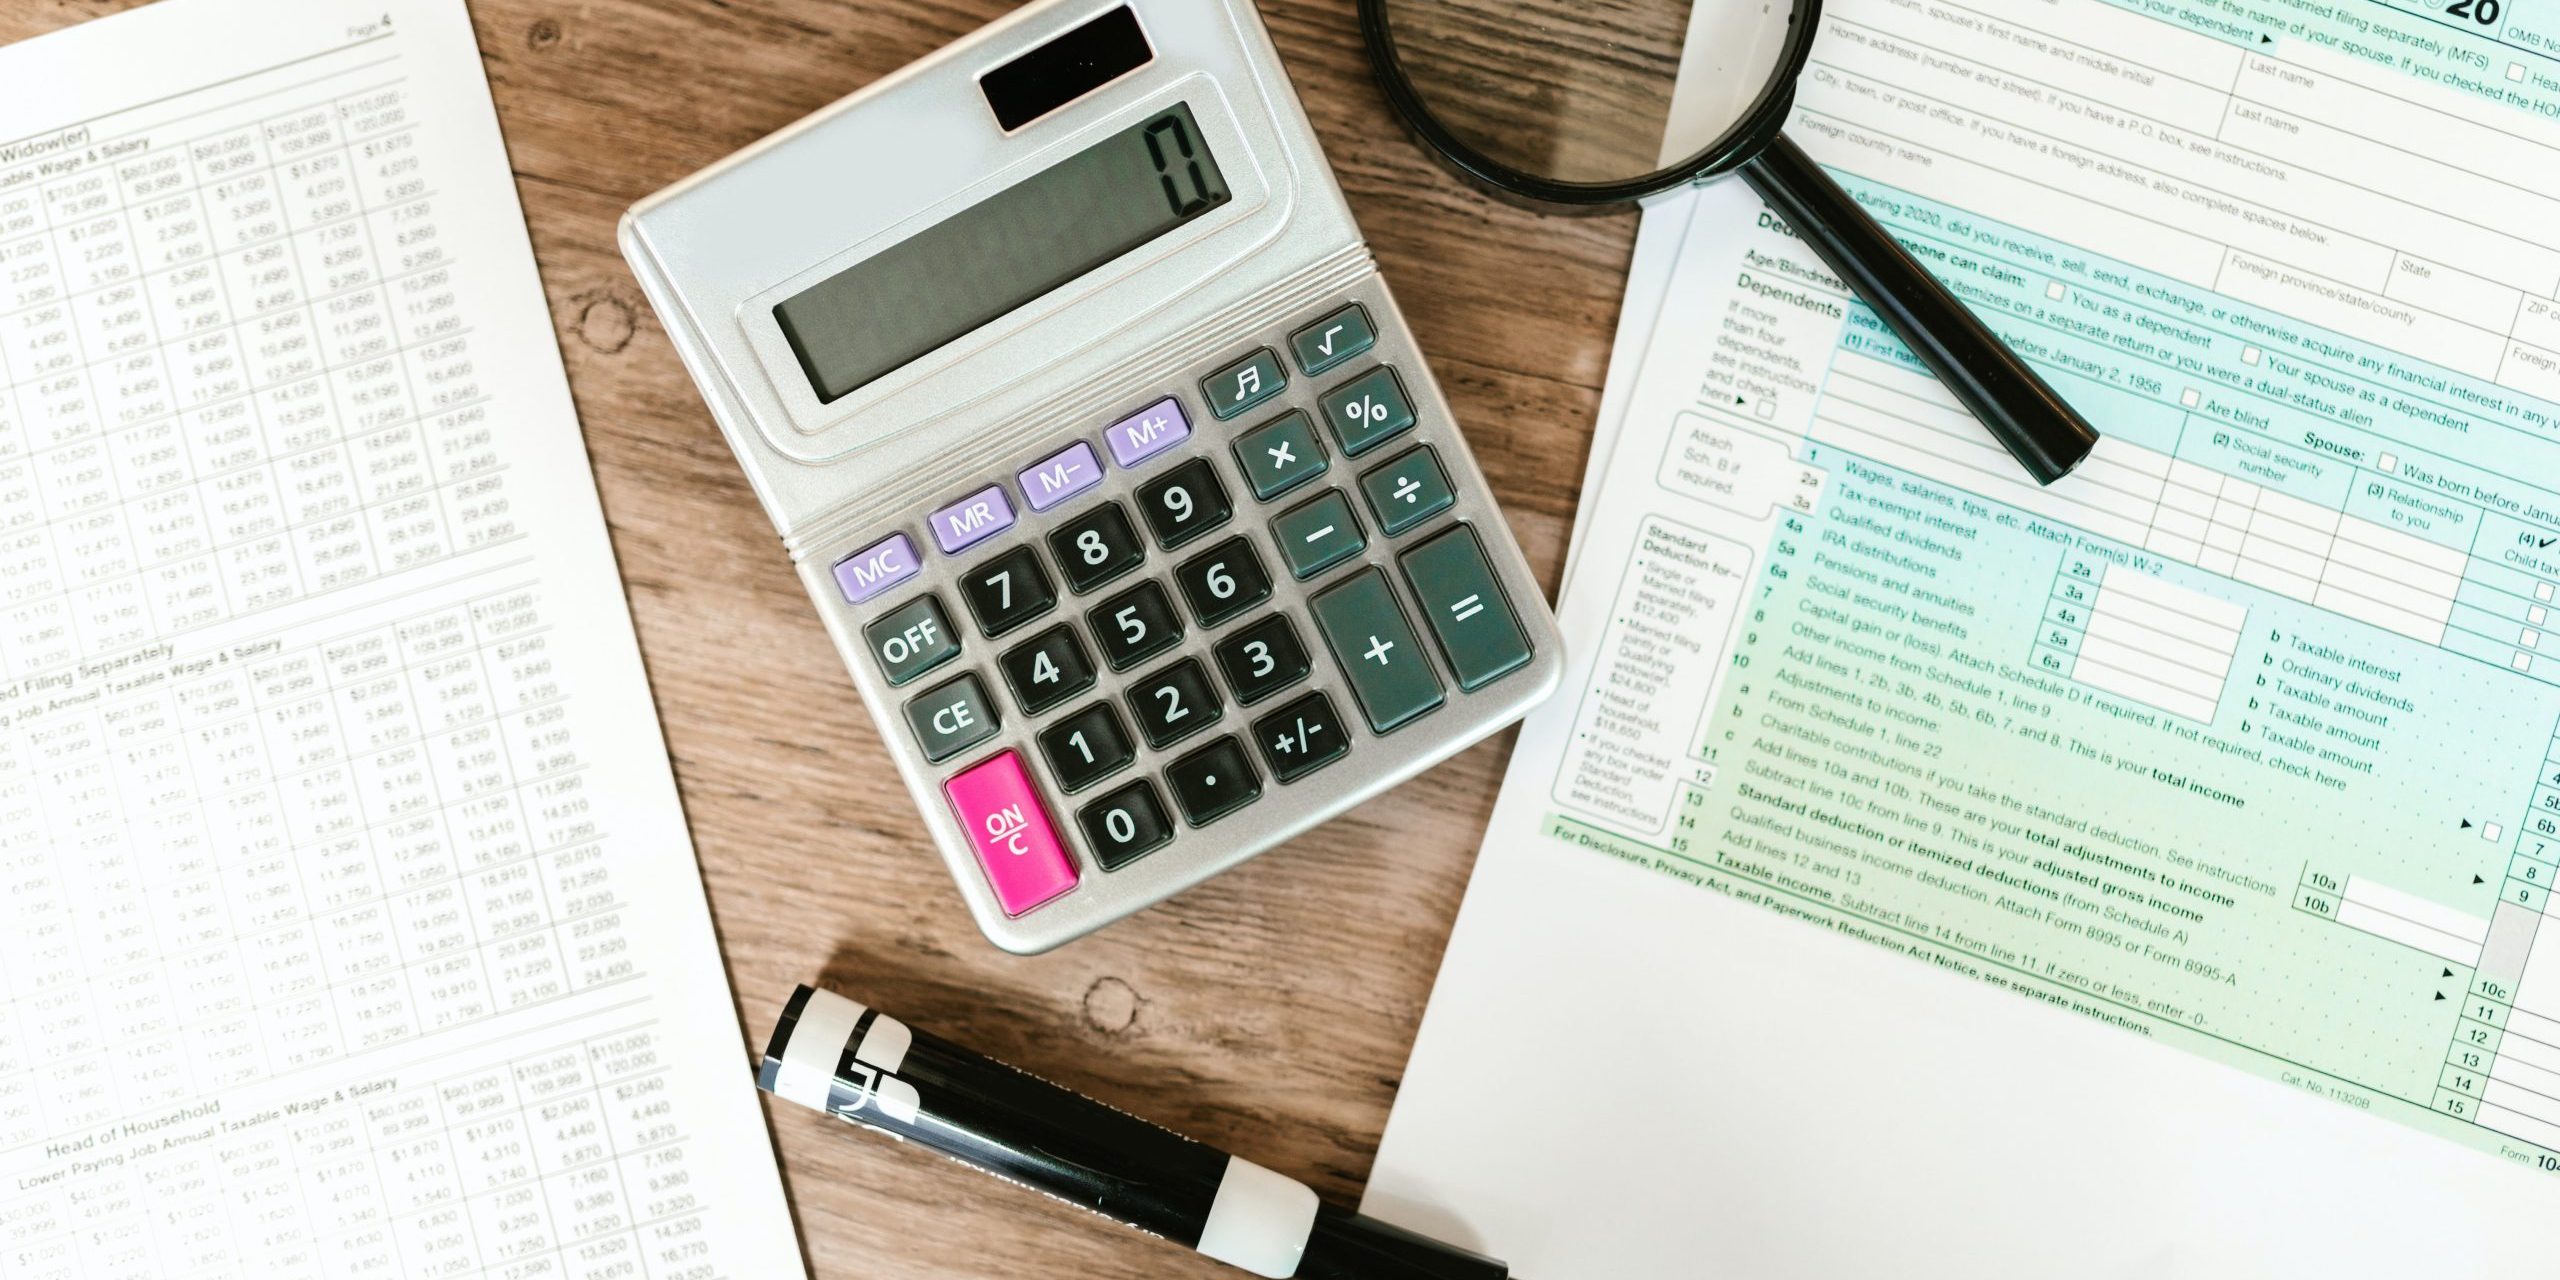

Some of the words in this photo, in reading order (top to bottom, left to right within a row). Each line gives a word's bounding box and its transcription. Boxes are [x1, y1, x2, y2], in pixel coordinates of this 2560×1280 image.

[2141, 0, 2177, 16] your
[2178, 7, 2255, 43] dependent
[2507, 26, 2541, 47] OMB
[2221, 0, 2245, 17] the
[2246, 9, 2287, 31] name
[2289, 23, 2306, 36] of
[2306, 28, 2340, 47] your
[2341, 40, 2396, 67] spouse.
[2400, 56, 2412, 71] If
[2412, 63, 2441, 81] you
[2442, 72, 2505, 101] checked
[2506, 91, 2530, 109] the
[2335, 8, 2369, 34] filing
[2371, 23, 2445, 58] separately
[2447, 45, 2490, 72] (MFS)
[2249, 58, 2278, 77] Last
[2278, 69, 2315, 89] name
[0, 126, 91, 163] Widow(er)
[37, 156, 83, 177] Wage
[86, 149, 99, 164] &
[100, 137, 150, 159] Salary
[2400, 258, 2432, 279] State
[1737, 272, 1843, 320] Dependents
[2230, 253, 2279, 281] Foreign
[2279, 272, 2416, 327] province/state/county
[2135, 282, 2206, 316] exchange,
[2211, 308, 2228, 321] or
[2229, 314, 2299, 345] otherwise
[2301, 337, 2355, 364] acquire
[2357, 356, 2385, 375] any
[2386, 362, 2447, 393] financial
[2449, 382, 2503, 412] interest
[2505, 401, 2520, 417] in
[2521, 409, 2550, 429] any
[1346, 395, 1387, 428] %
[2268, 355, 2301, 378] Your
[2303, 370, 2356, 396] spouse
[2358, 389, 2376, 403] as
[2378, 395, 2389, 408] a
[2392, 399, 2470, 434] dependent
[2204, 399, 2231, 418] Are
[2233, 407, 2270, 431] blind
[1127, 417, 1167, 448] M+
[2303, 431, 2365, 462] Spouse:
[2212, 430, 2231, 449] (2)
[2232, 437, 2272, 460] Social
[2273, 454, 2324, 479] security
[2238, 459, 2288, 483] number
[1164, 487, 1192, 522] 9
[2367, 481, 2385, 500] (3)
[2387, 488, 2464, 524] Relationship
[2403, 463, 2434, 485] Was
[2437, 474, 2471, 497] born
[2473, 486, 2520, 513] before
[950, 503, 994, 536] MR
[2391, 508, 2404, 522] to
[2405, 515, 2431, 531] you
[1077, 531, 1108, 564] 8
[2504, 548, 2539, 569] Child
[2540, 560, 2560, 577] tax
[854, 549, 900, 587] MC
[1207, 563, 1235, 598] 6
[986, 571, 1010, 609] 7
[884, 619, 936, 663] OFF
[1116, 606, 1146, 643] 5
[23, 672, 74, 695] Filing
[77, 643, 175, 680] Separately
[1034, 651, 1059, 683] 4
[1244, 641, 1274, 677] 3
[2270, 628, 2281, 643] b
[2291, 634, 2345, 665] Taxable
[2347, 657, 2402, 684] interest
[15, 705, 43, 722] Job
[47, 687, 101, 712] Annual
[105, 671, 166, 695] Taxable
[168, 657, 214, 678] Wage
[218, 651, 230, 666] &
[233, 639, 282, 661] Salary
[934, 701, 974, 734] CE
[1157, 686, 1188, 722] 2
[1070, 731, 1094, 763] 1
[1275, 718, 1321, 753] +/-
[2152, 768, 2187, 789] total
[2189, 780, 2245, 809] income
[985, 805, 1025, 838] ON
[1106, 809, 1134, 842] 0
[2537, 818, 2557, 835] 6b
[1008, 832, 1029, 856] C
[2535, 842, 2545, 856] 7
[1737, 782, 1807, 817] Standard
[1809, 808, 1885, 843] deduction
[1887, 836, 1905, 848] or
[1907, 840, 1974, 872] itemized
[1975, 863, 2060, 901] deductions
[2062, 892, 2100, 915] (from
[2103, 906, 2170, 938] Schedule
[2172, 929, 2189, 946] A)
[2525, 866, 2537, 880] 8
[2032, 859, 2100, 889] adjusted
[2102, 882, 2145, 904] gross
[2148, 894, 2204, 923] income
[2312, 872, 2337, 891] 10a
[2518, 889, 2529, 903] 9
[2305, 895, 2330, 914] 10b
[1553, 824, 1576, 841] For
[1578, 833, 1651, 869] Disclosure,
[1654, 858, 1704, 887] Privacy
[1705, 877, 1731, 897] Act,
[1735, 889, 1762, 904] and
[1763, 895, 1834, 930] Paperwork
[1837, 921, 1906, 953] Reduction
[1907, 945, 1932, 963] Act
[1933, 953, 1980, 980] Notice,
[1983, 972, 2009, 988] see
[2010, 981, 2069, 1009] separate
[2071, 1000, 2153, 1037] instructions.
[2481, 981, 2507, 999] 10c
[2478, 1005, 2494, 1021] 11
[2470, 1029, 2488, 1045] 12
[2463, 1052, 2480, 1068] 13
[2280, 1071, 2303, 1088] Cat.
[2305, 1079, 2325, 1096] No.
[2328, 1087, 2371, 1110] 11320B
[2455, 1076, 2472, 1091] 14
[2447, 1098, 2465, 1114] 15
[17, 1169, 66, 1191] Lower
[71, 1153, 125, 1176] Paying
[129, 1143, 158, 1160] Job
[162, 1125, 216, 1151] Annual
[220, 1110, 281, 1134] Taxable
[283, 1097, 329, 1116] Wage
[333, 1090, 345, 1103] &
[348, 1077, 398, 1099] Salary
[45, 1133, 95, 1160] Head
[99, 1127, 117, 1144] of
[122, 1099, 221, 1138] Household
[2499, 1144, 2531, 1164] Form
